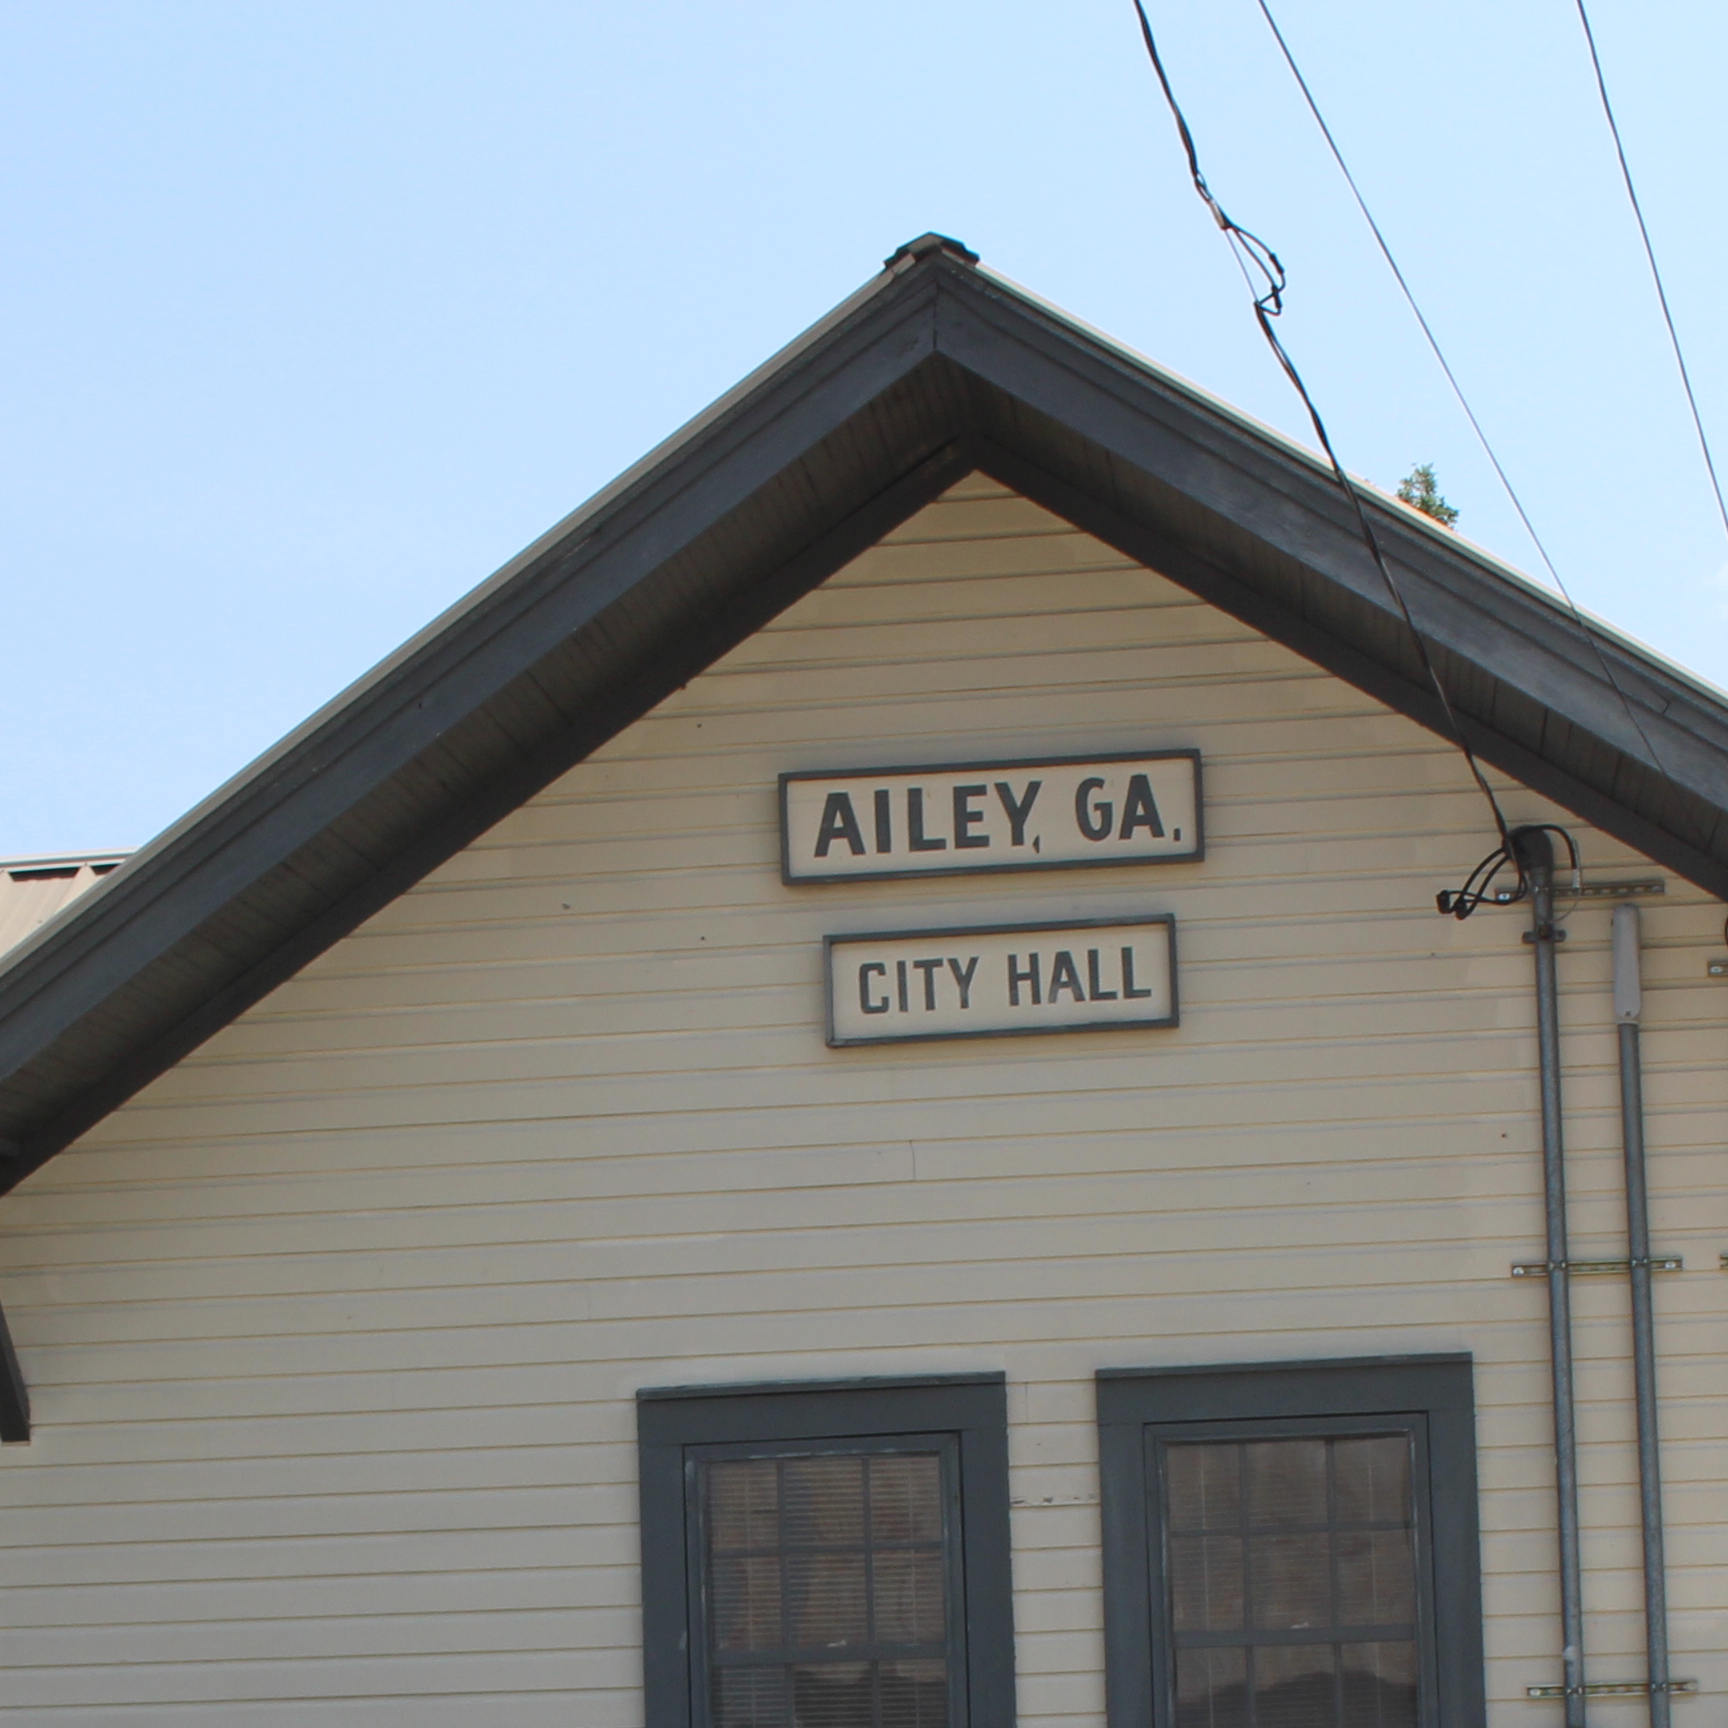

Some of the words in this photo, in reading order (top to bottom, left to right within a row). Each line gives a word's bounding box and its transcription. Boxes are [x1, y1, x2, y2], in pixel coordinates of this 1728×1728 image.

[813, 780, 1043, 858] AILEY,
[1075, 773, 1182, 842] GA.
[858, 956, 980, 1015] CITY
[1007, 946, 1153, 1007] HALL
